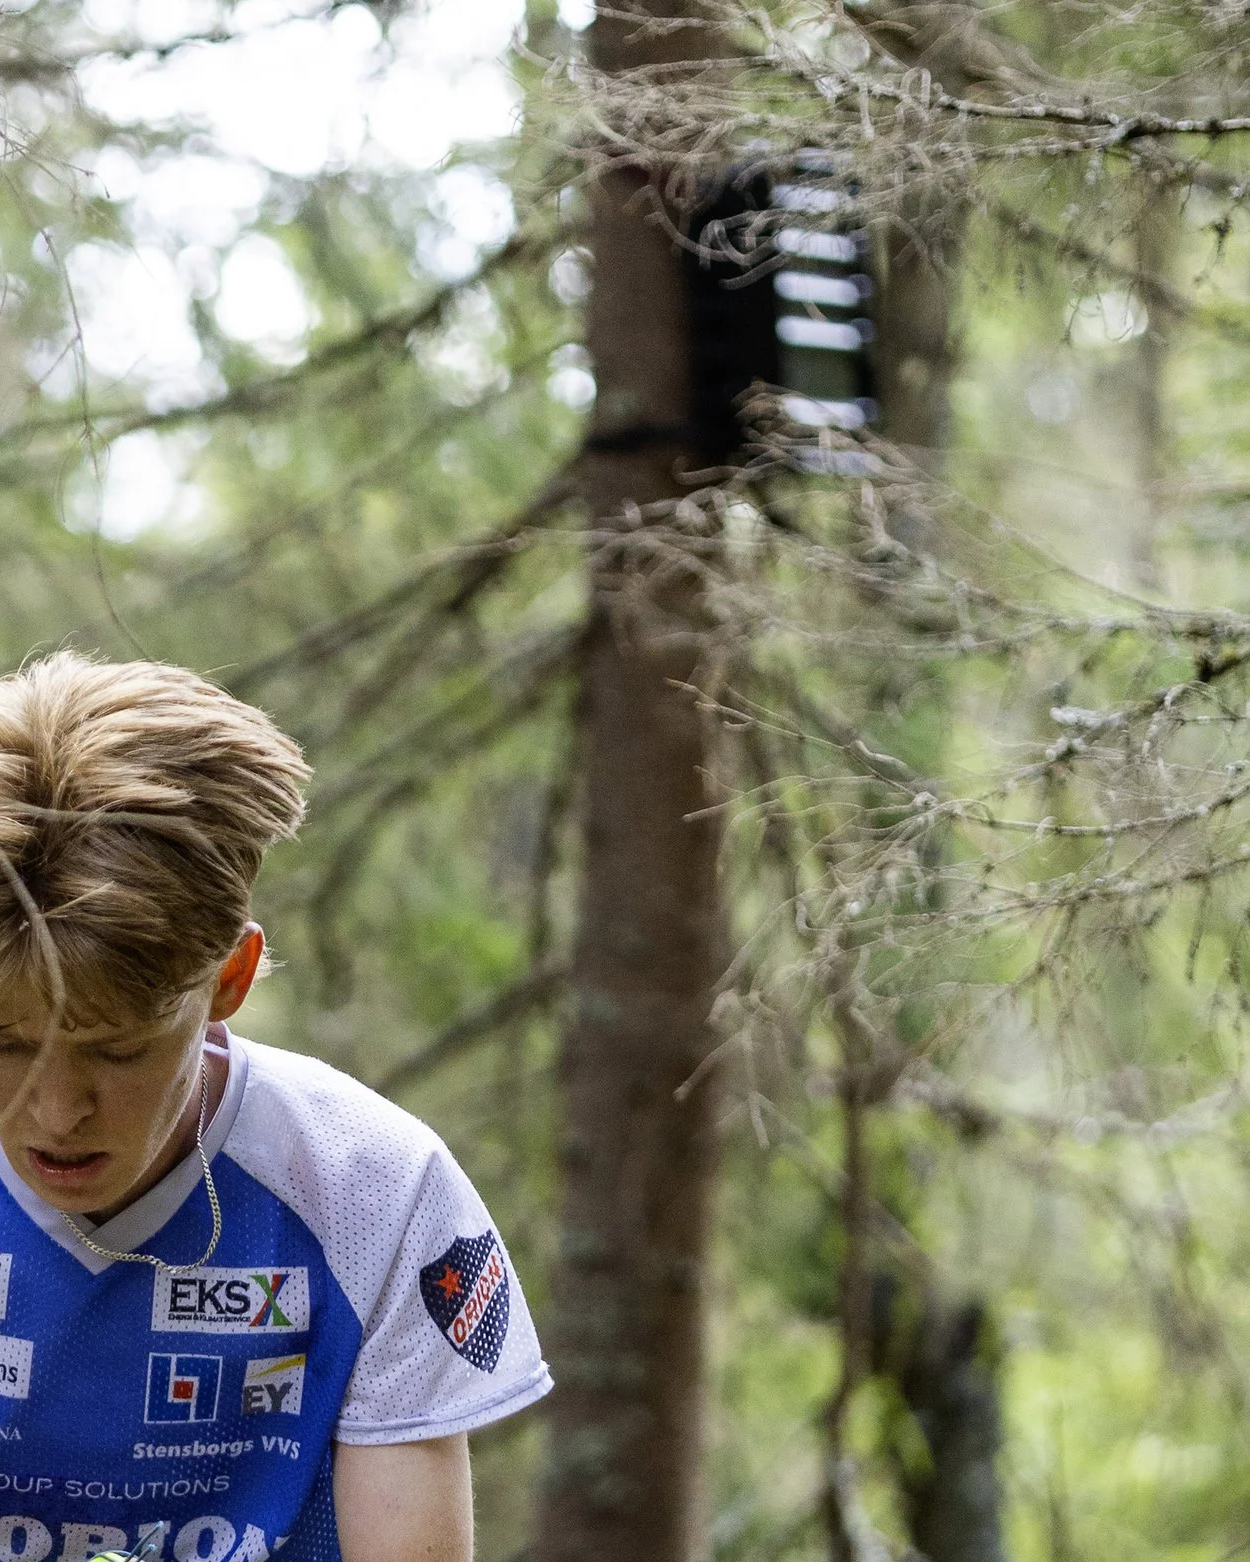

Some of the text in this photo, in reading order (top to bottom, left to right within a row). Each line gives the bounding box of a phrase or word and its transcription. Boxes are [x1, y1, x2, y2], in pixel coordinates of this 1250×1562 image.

[453, 1254, 502, 1344] ORION
[243, 1381, 293, 1416] EY
[133, 1435, 301, 1460] Stensborgs VVS
[65, 1476, 231, 1500] SOLUTIONS
